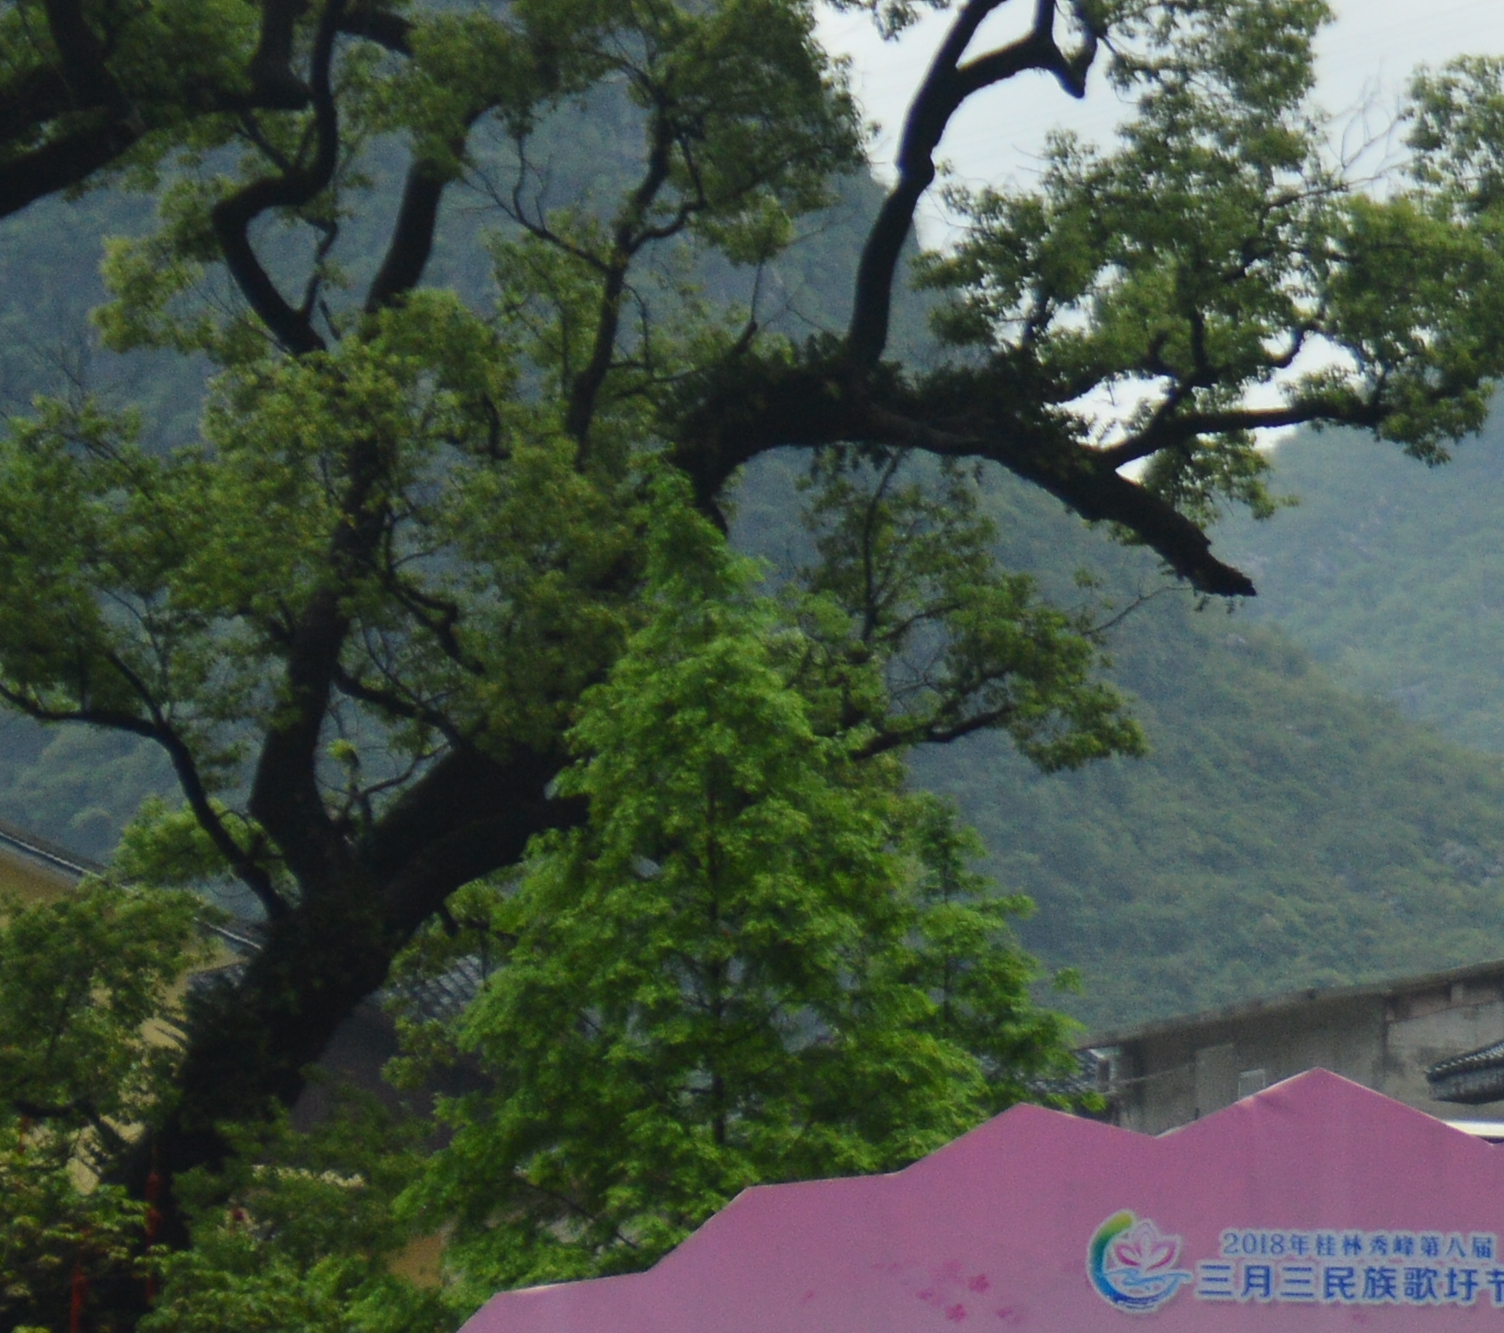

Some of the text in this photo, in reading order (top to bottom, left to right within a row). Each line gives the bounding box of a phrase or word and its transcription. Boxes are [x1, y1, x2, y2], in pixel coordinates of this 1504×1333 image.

[1222, 1231, 1494, 1258] 2018年桂林秀峰第八届
